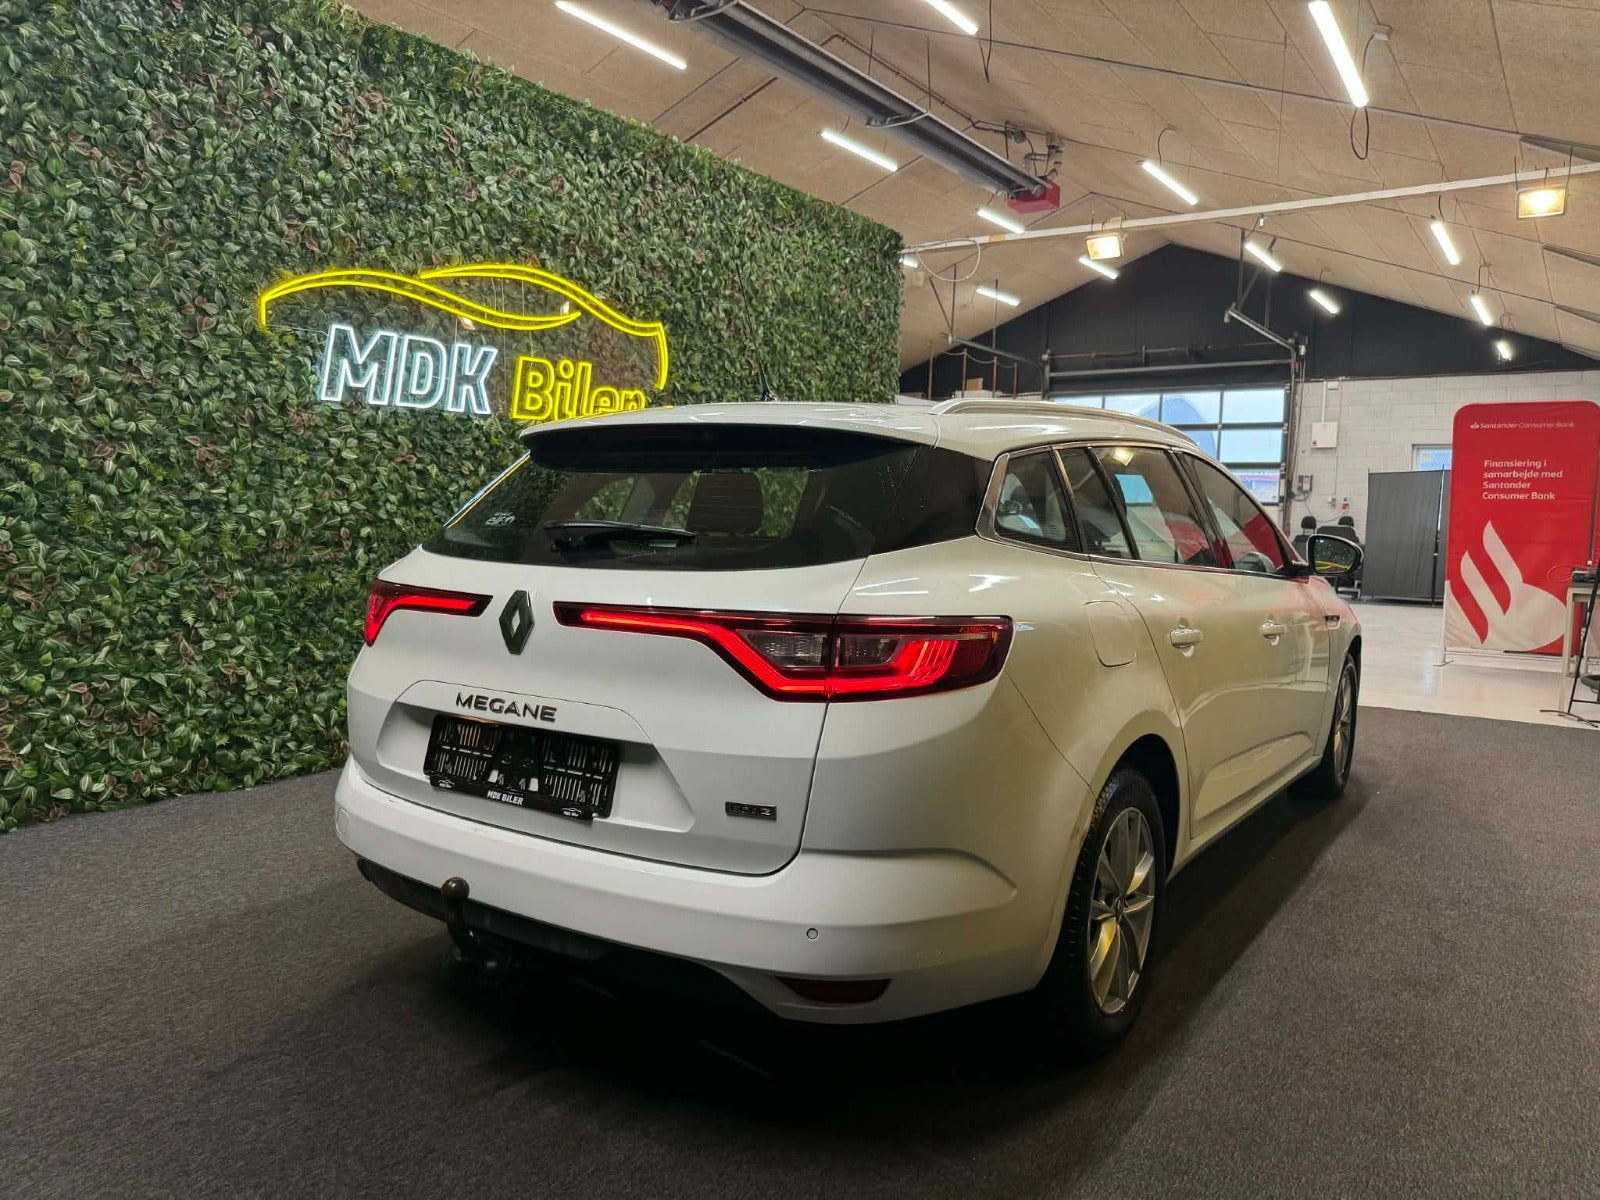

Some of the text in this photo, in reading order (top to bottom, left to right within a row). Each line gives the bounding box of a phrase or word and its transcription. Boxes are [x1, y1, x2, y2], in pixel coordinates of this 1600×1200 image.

[320, 324, 498, 415] MDK
[1484, 459, 1542, 470] Finansiering
[1482, 469, 1563, 480] samarbejde med
[1482, 481, 1531, 489] Santander
[1482, 491, 1555, 500] Consumer Bank
[455, 692, 558, 723] MEGANE
[501, 793, 524, 806] BILER
